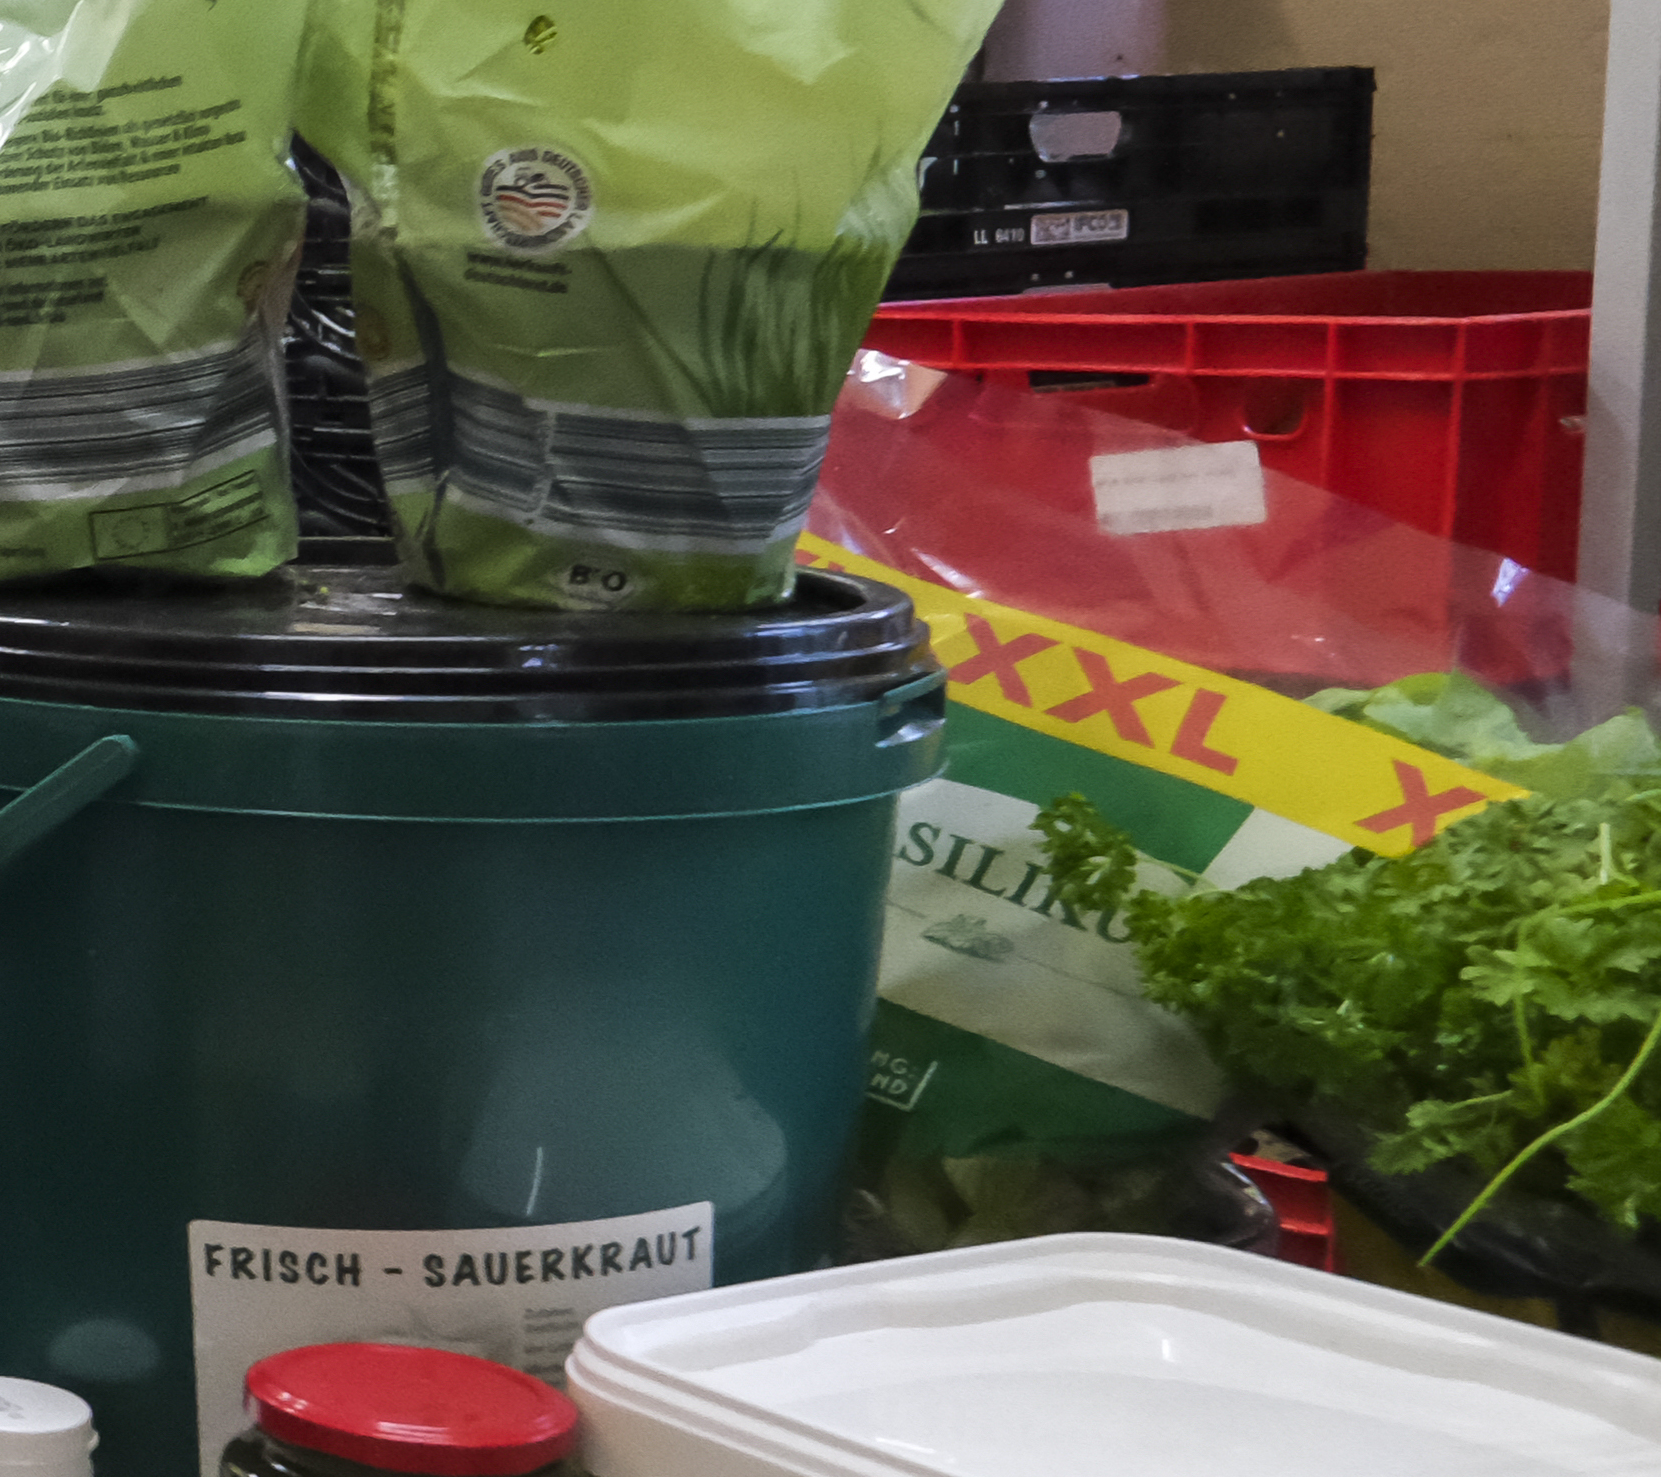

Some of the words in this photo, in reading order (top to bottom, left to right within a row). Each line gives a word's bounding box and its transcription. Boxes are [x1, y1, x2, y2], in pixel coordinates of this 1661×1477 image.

[949, 611, 1239, 776] XXL
[203, 1242, 362, 1287] FRISCH
[423, 1226, 703, 1288] SAUERKRAUT
